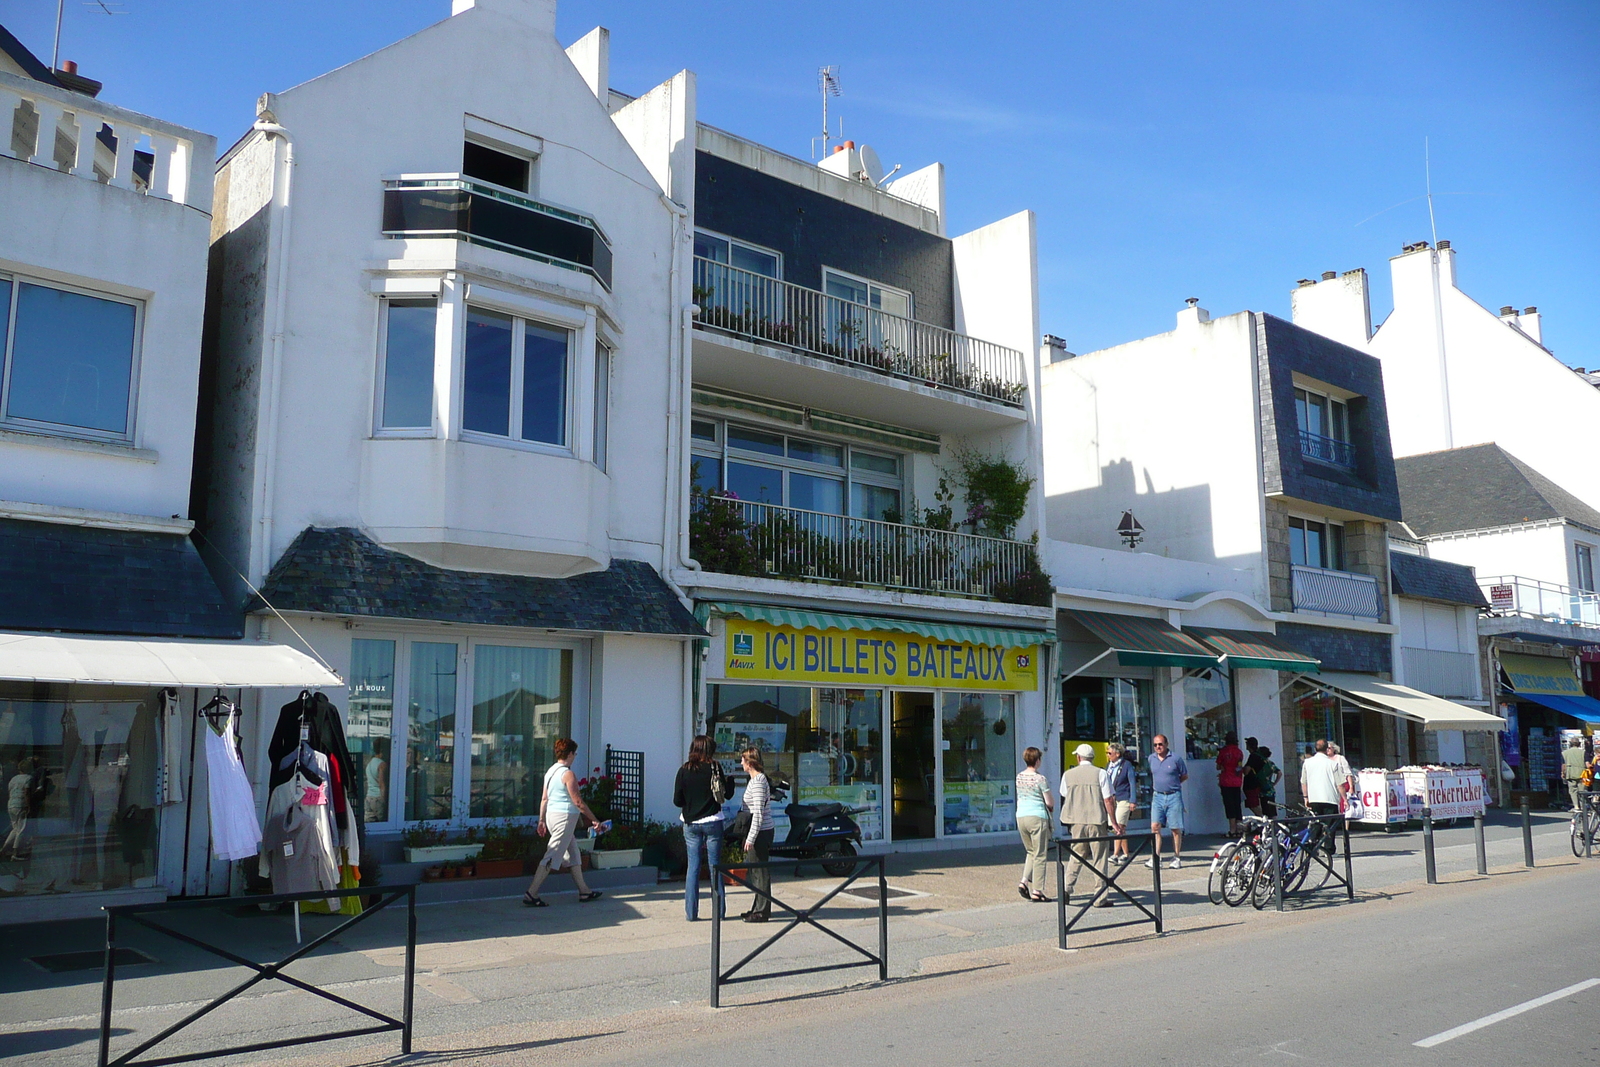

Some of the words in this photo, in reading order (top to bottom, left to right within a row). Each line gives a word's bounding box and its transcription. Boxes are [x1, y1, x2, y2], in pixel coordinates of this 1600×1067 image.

[765, 631, 796, 671] ICI
[804, 634, 897, 677] BILLETS
[907, 641, 1007, 682] BATEAUX
[355, 684, 363, 692] LE
[1509, 672, 1561, 691] BRETAGNE
[1556, 675, 1579, 692] SUD
[1362, 790, 1382, 808] er
[1364, 810, 1383, 820] ESS
